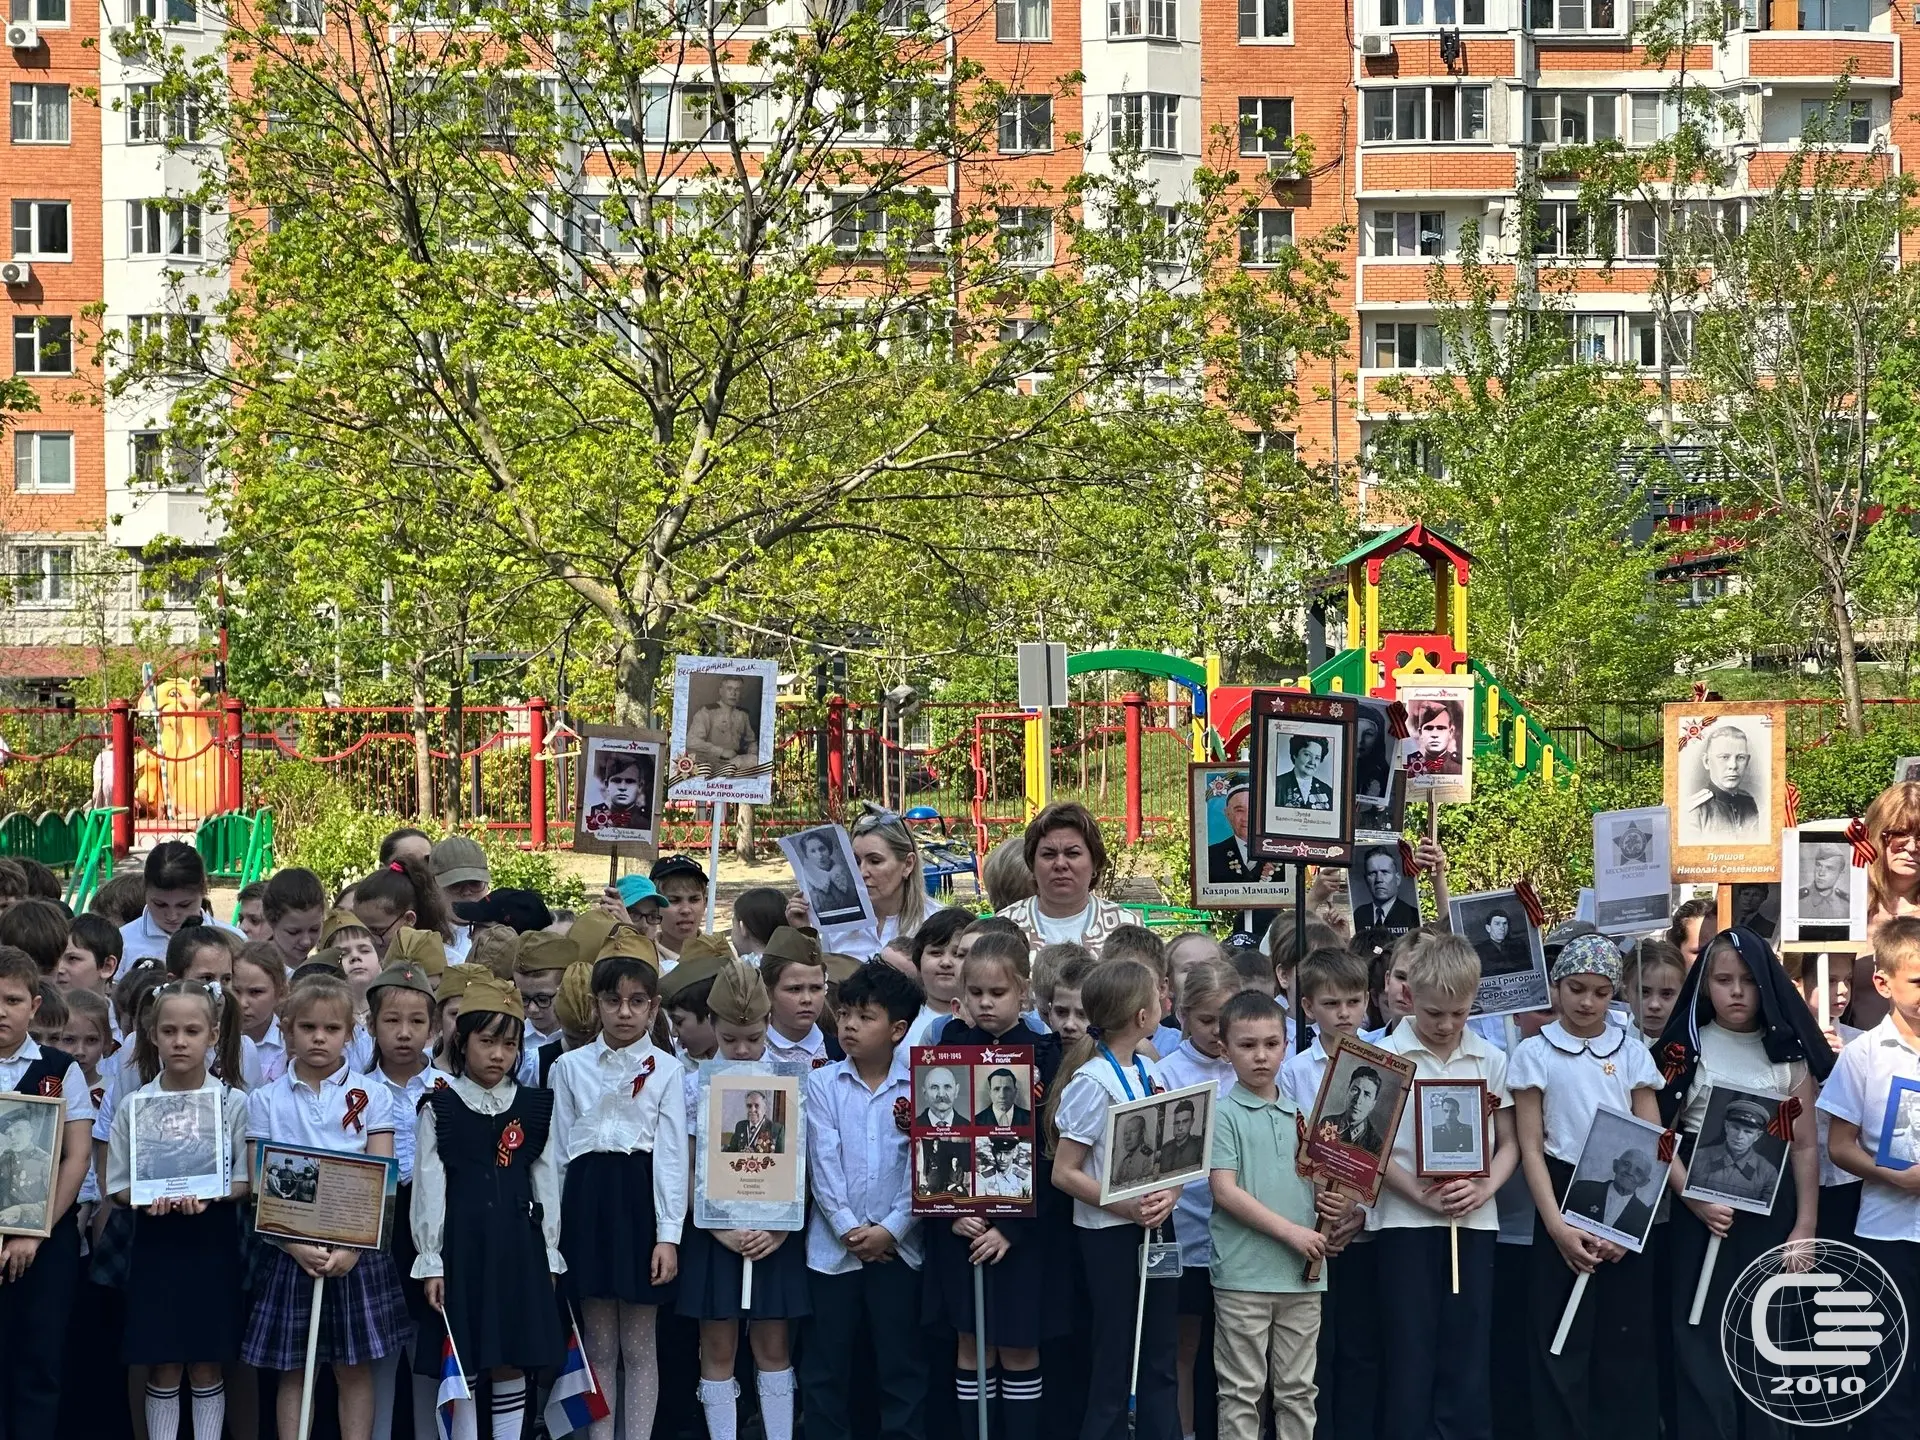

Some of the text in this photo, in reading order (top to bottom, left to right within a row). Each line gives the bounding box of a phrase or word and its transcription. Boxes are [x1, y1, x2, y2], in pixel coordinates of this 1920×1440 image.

[706, 782, 734, 790] БЕЛЯЕВ
[675, 788, 764, 800] АЛЕКСАНДР ПРОХОРОВИЧ
[1676, 864, 1718, 875] Николай
[1202, 885, 1290, 897] Кахаров Мамадьяр
[1498, 970, 1542, 986] Григорий
[1481, 987, 1530, 1000] Сергеевич
[509, 1131, 517, 1143] 9
